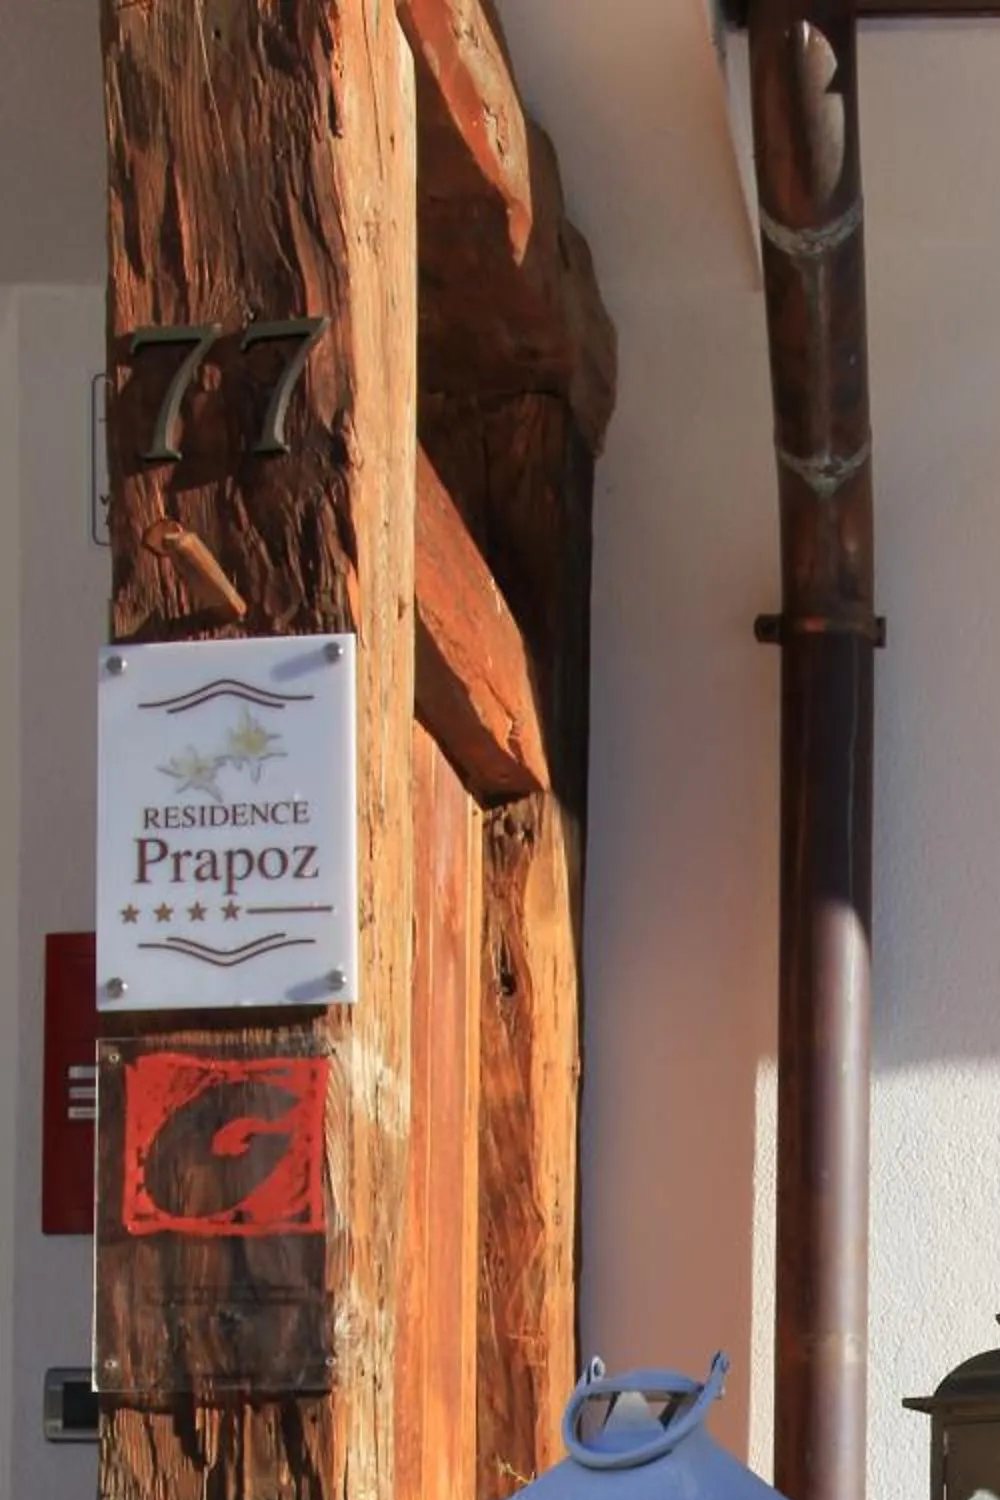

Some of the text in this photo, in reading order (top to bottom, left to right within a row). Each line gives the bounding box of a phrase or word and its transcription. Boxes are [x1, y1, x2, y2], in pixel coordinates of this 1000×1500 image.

[131, 318, 328, 460] 77
[143, 802, 310, 830] RESIDENCE
[133, 837, 319, 895] Prapoz
